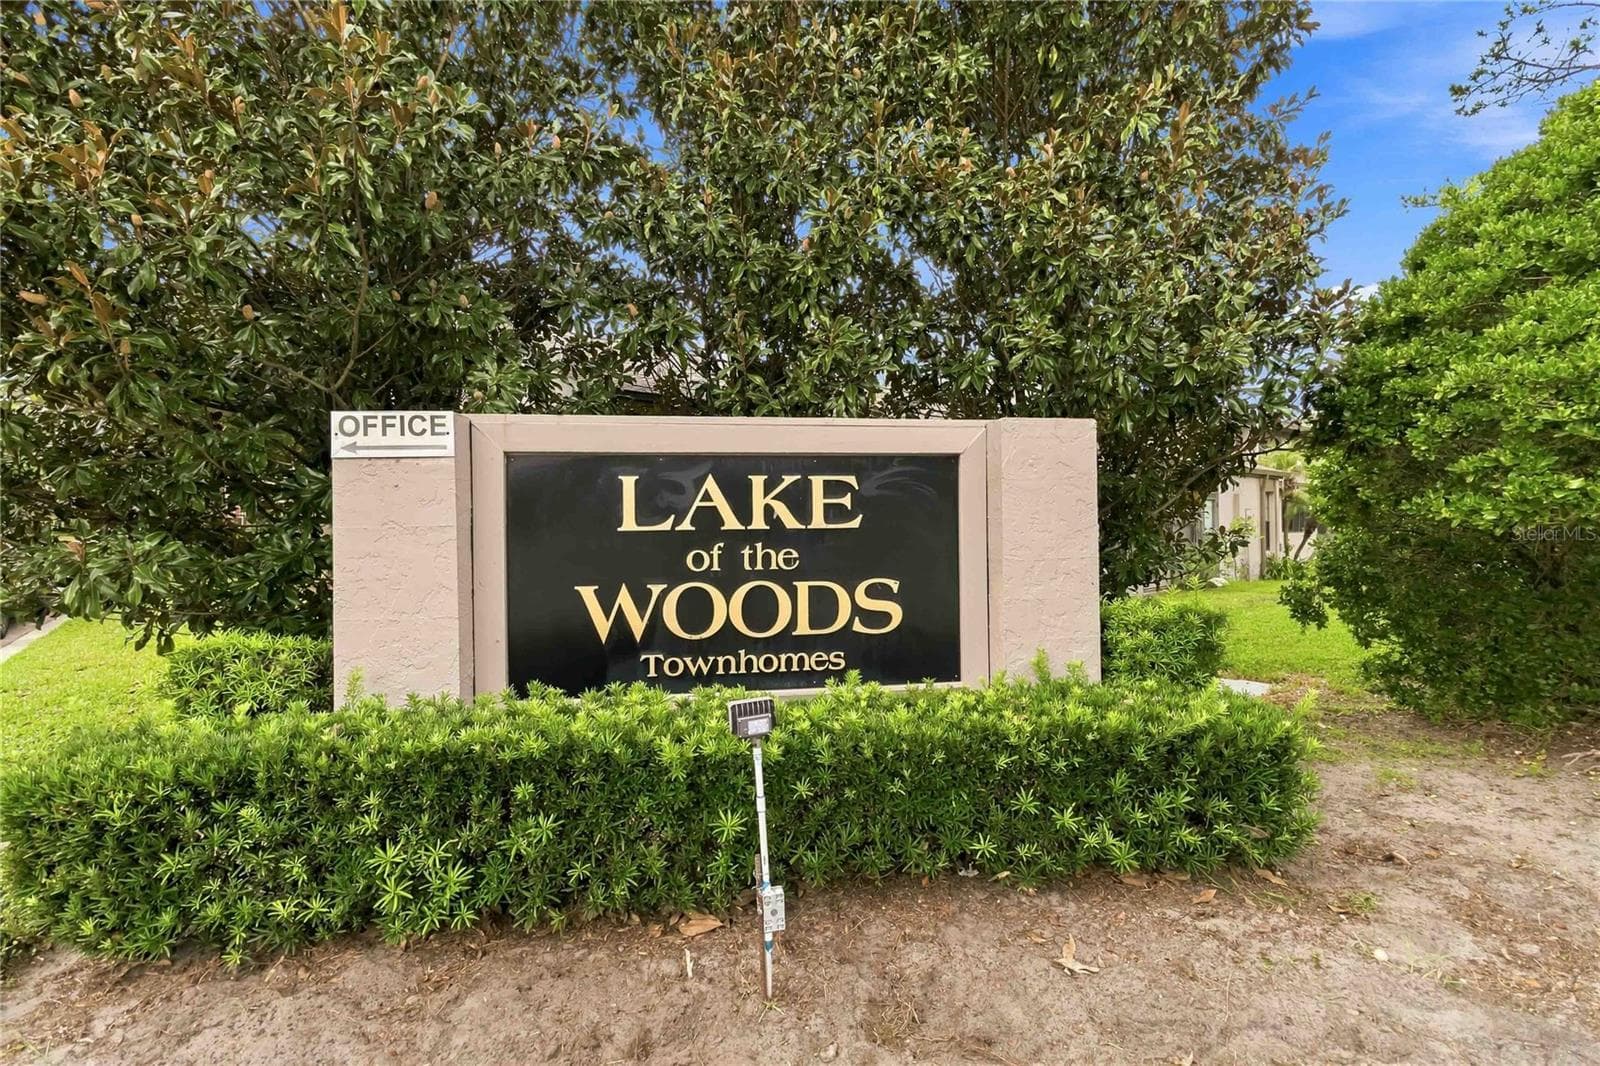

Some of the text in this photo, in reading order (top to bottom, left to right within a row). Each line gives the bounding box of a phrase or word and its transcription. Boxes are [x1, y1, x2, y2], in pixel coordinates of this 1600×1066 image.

[338, 414, 447, 438] OFFICE
[617, 473, 863, 532] LAKE
[686, 542, 800, 572] of the
[574, 577, 904, 646] WOODS
[640, 649, 846, 678] Townhomes
